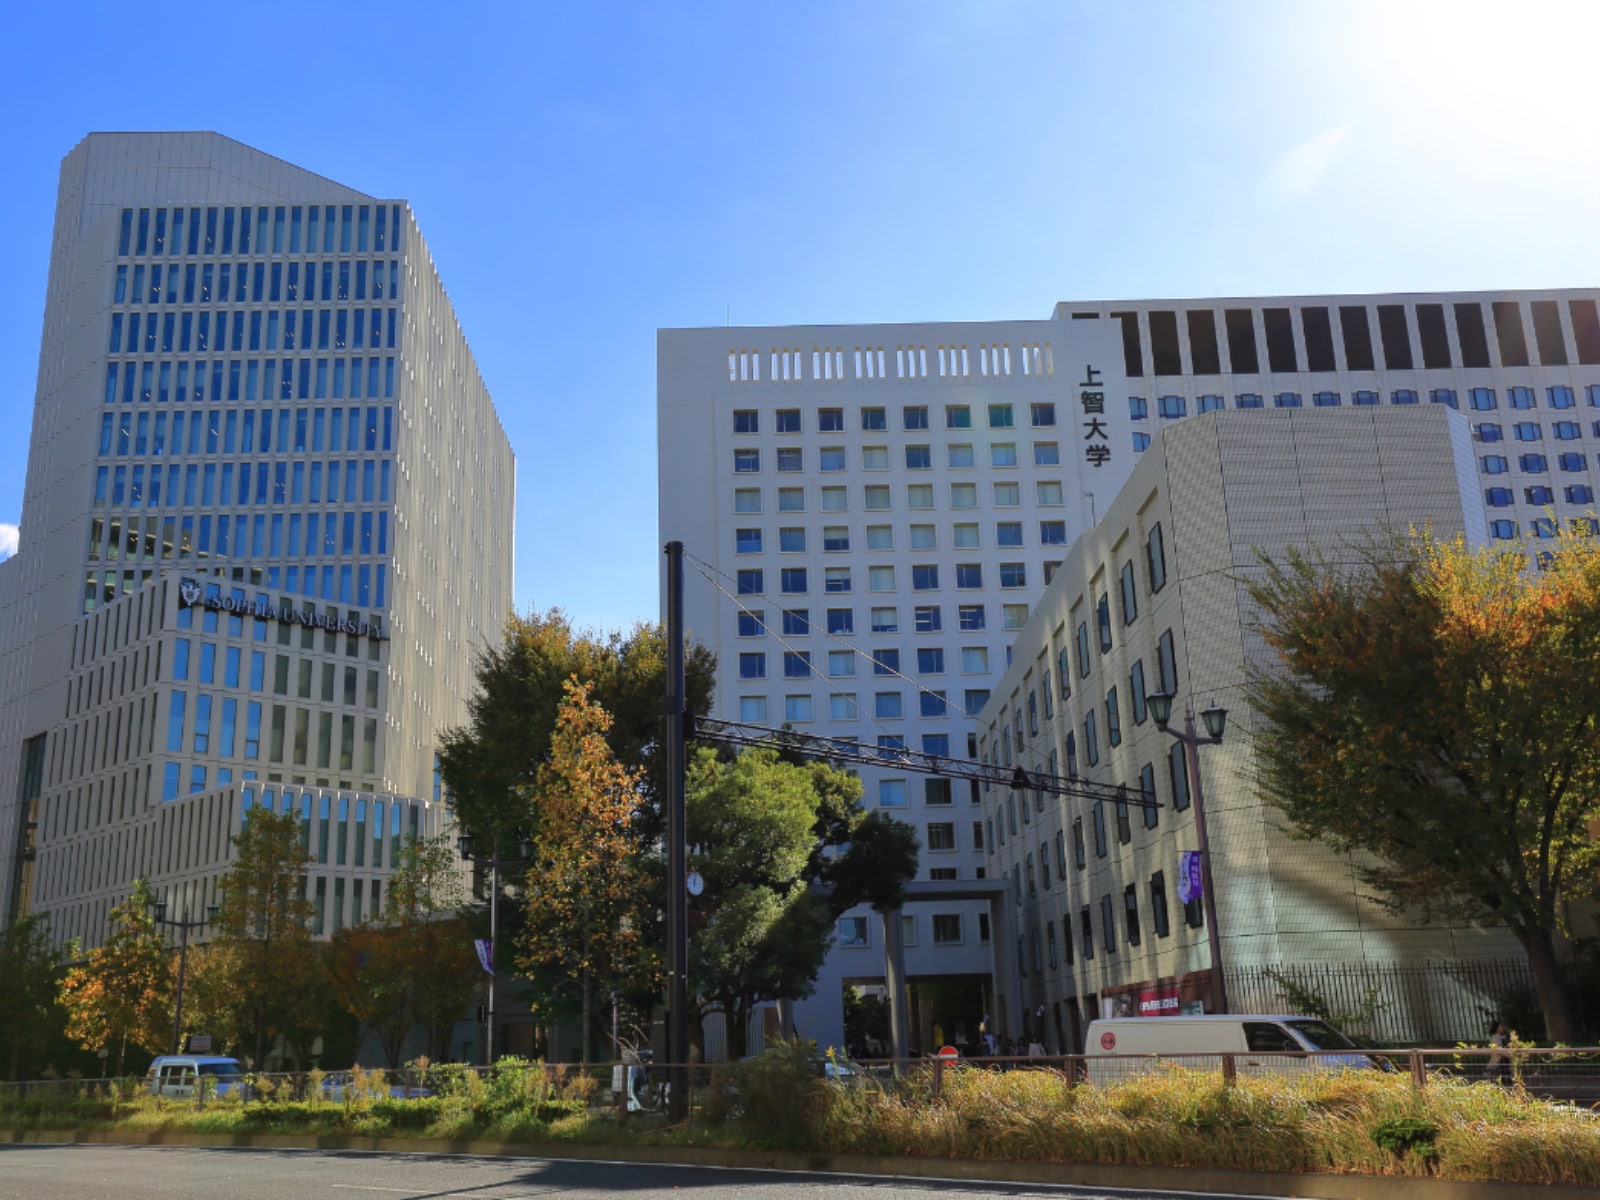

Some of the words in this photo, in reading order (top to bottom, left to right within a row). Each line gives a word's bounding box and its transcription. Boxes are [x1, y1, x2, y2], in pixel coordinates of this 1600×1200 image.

[1079, 364, 1111, 467] 上智大学
[211, 595, 279, 619] SOPHIA
[283, 607, 381, 638] UNIVERSITY
